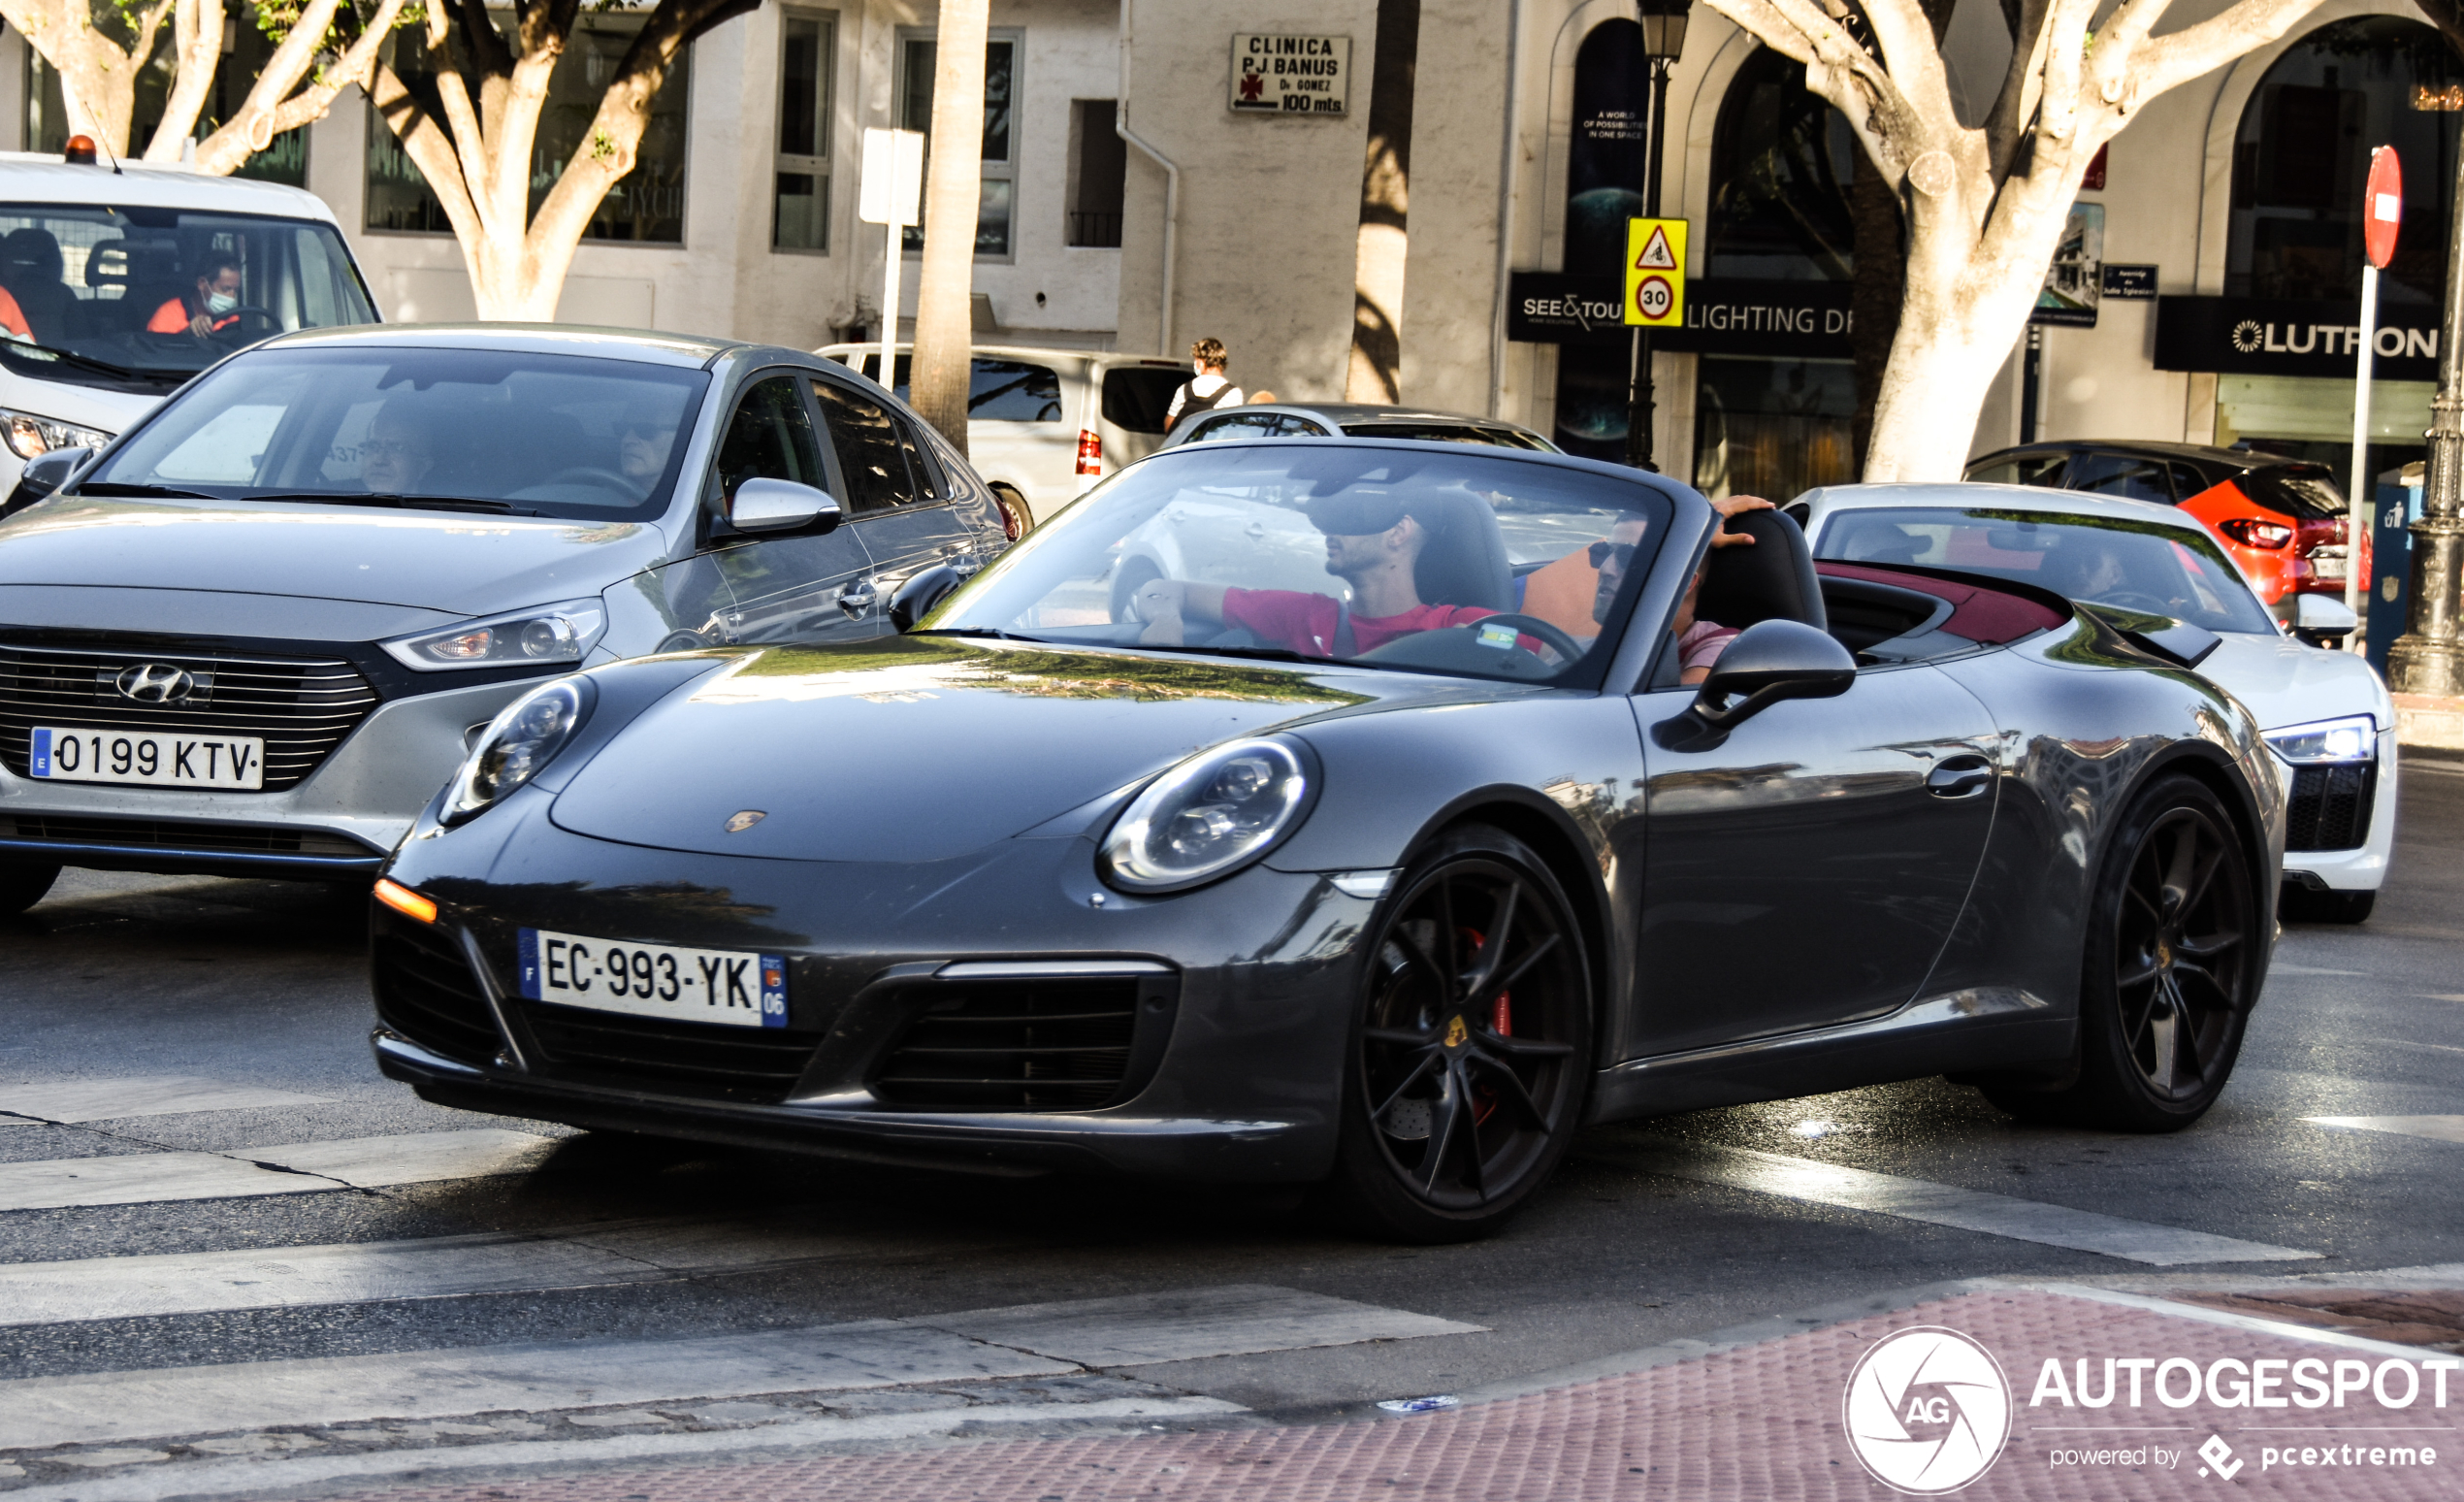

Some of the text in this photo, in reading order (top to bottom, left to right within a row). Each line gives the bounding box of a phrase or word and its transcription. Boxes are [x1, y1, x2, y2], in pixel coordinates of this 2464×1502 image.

[1249, 37, 1332, 55] CLINICA
[1274, 57, 1339, 76] BANUS
[1297, 80, 1331, 92] GOMEZ
[1282, 94, 1311, 111] 100
[1605, 111, 1636, 119] WORLD
[1599, 130, 1615, 139] ONE
[1616, 131, 1642, 140] SPACE
[1643, 290, 1666, 306] 30
[1687, 304, 1815, 334] LIGHTING
[38, 758, 46, 768] E
[59, 735, 251, 780] 0199 KTV
[525, 966, 534, 981] F
[546, 938, 753, 1009] EC-993-YK
[763, 992, 785, 1015] 06
